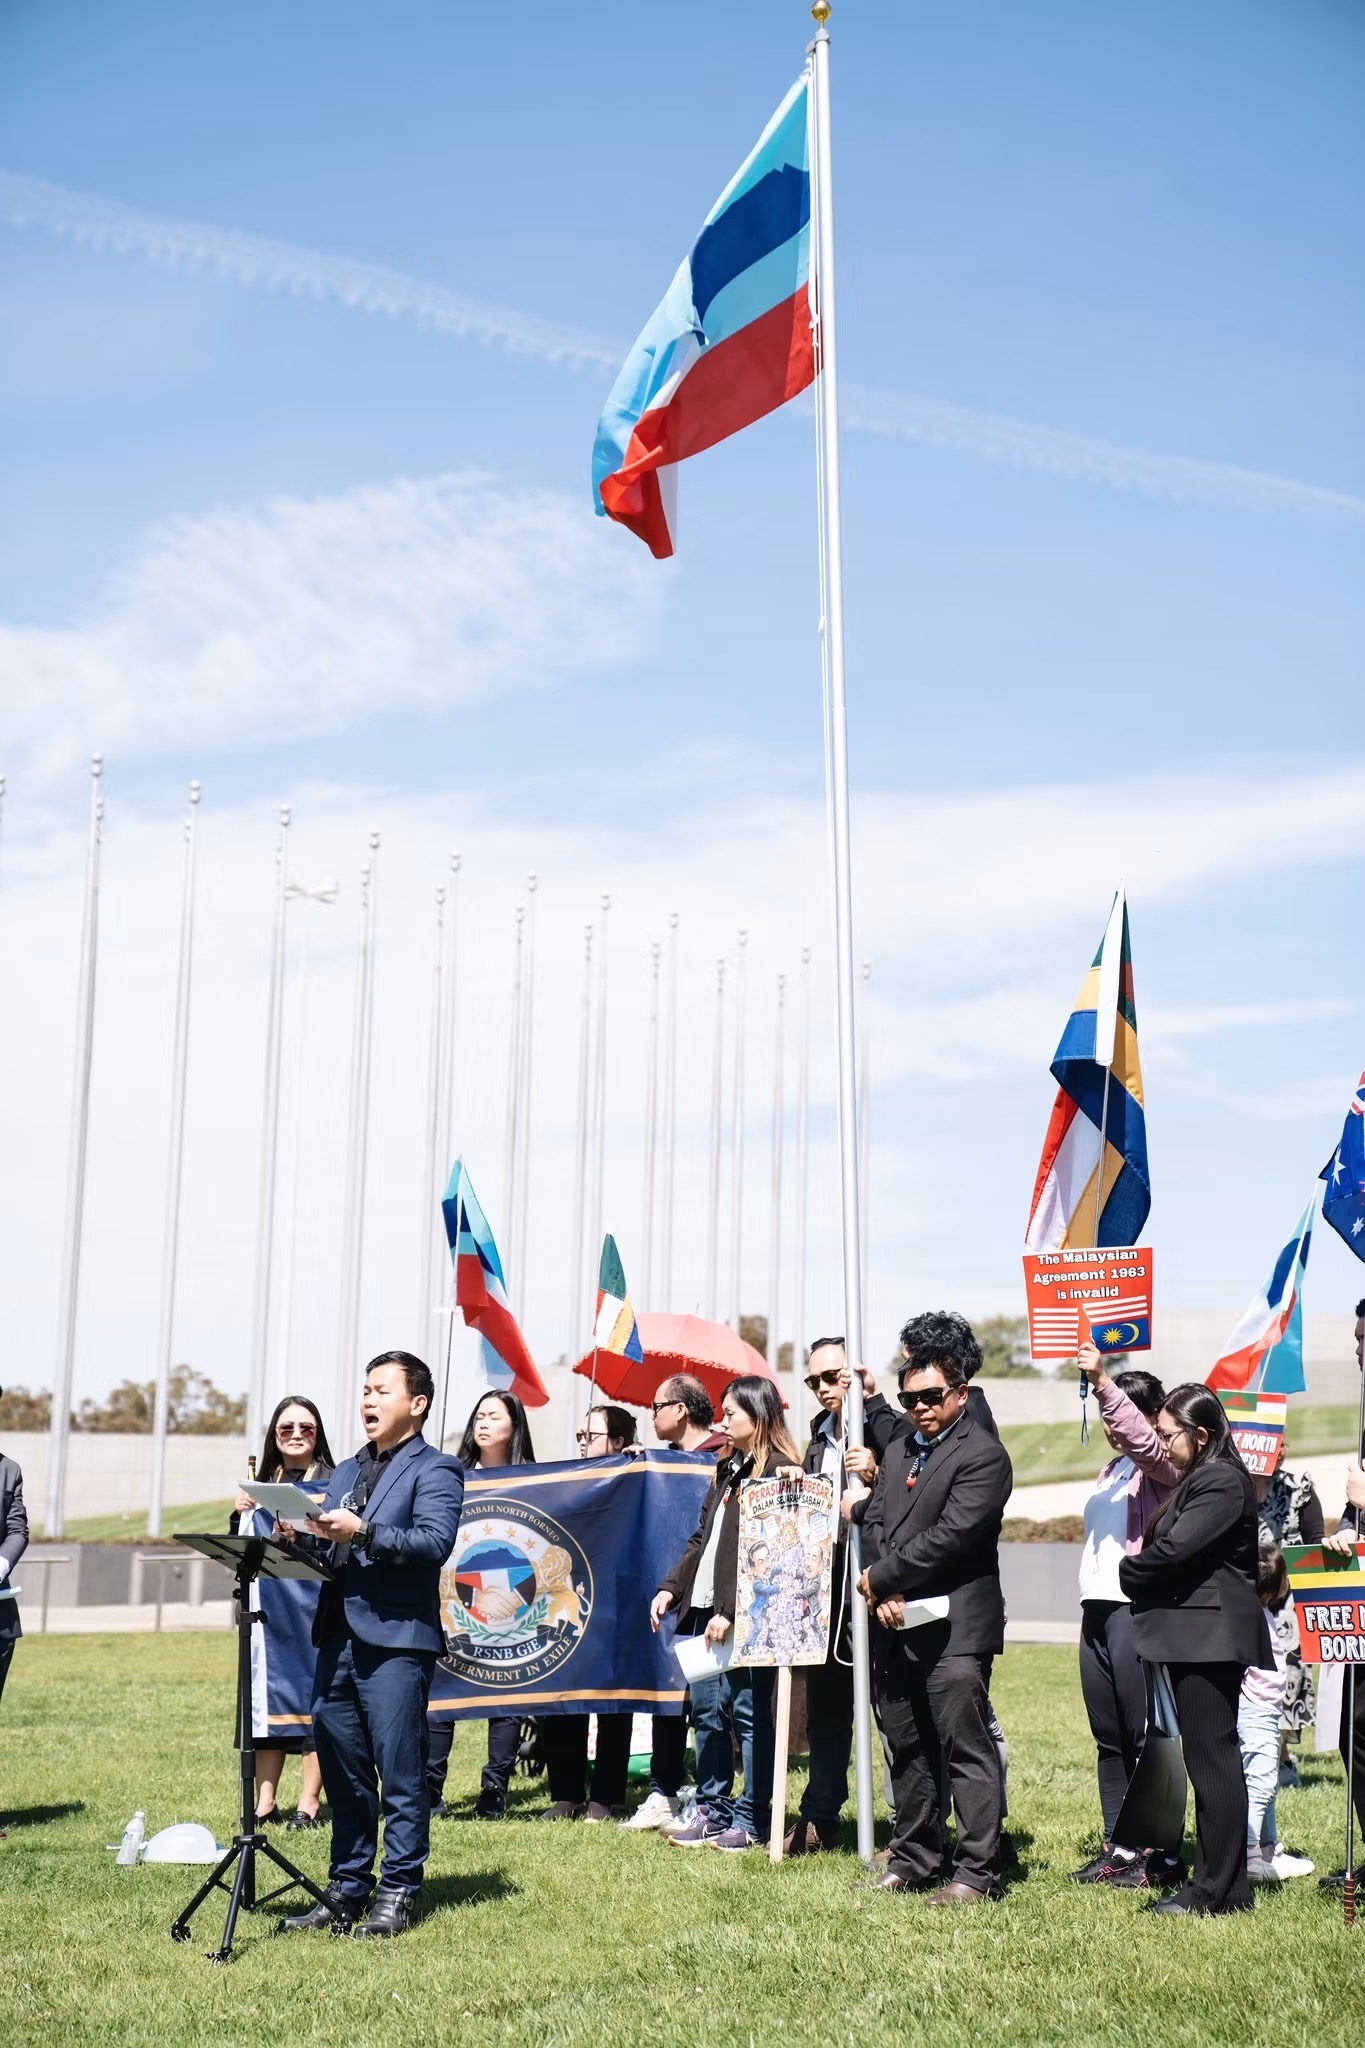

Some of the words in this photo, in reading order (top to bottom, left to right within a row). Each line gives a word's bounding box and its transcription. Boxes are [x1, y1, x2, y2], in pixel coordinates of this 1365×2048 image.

[1037, 1255, 1060, 1265] The
[1063, 1249, 1138, 1264] Malaysian
[1033, 1271, 1106, 1285] Agreement
[1110, 1266, 1146, 1279] 1963
[1057, 1289, 1067, 1300] is
[1070, 1286, 1119, 1299] invalid
[1241, 1432, 1278, 1454] NORTH
[748, 1480, 792, 1507] PERASUAH
[793, 1479, 830, 1500] TERBESAR
[752, 1500, 774, 1514] DALAM
[801, 1494, 825, 1510] SABAH!
[465, 1504, 494, 1517] SABAH
[496, 1505, 528, 1519] NORTH
[528, 1514, 561, 1542] BORNEO
[1303, 1604, 1355, 1632] FREE
[443, 1655, 521, 1681] OVERNMENT
[525, 1662, 541, 1677] IN
[542, 1636, 572, 1668] EXILE
[472, 1646, 513, 1660] RSNB
[516, 1638, 541, 1657] GiE
